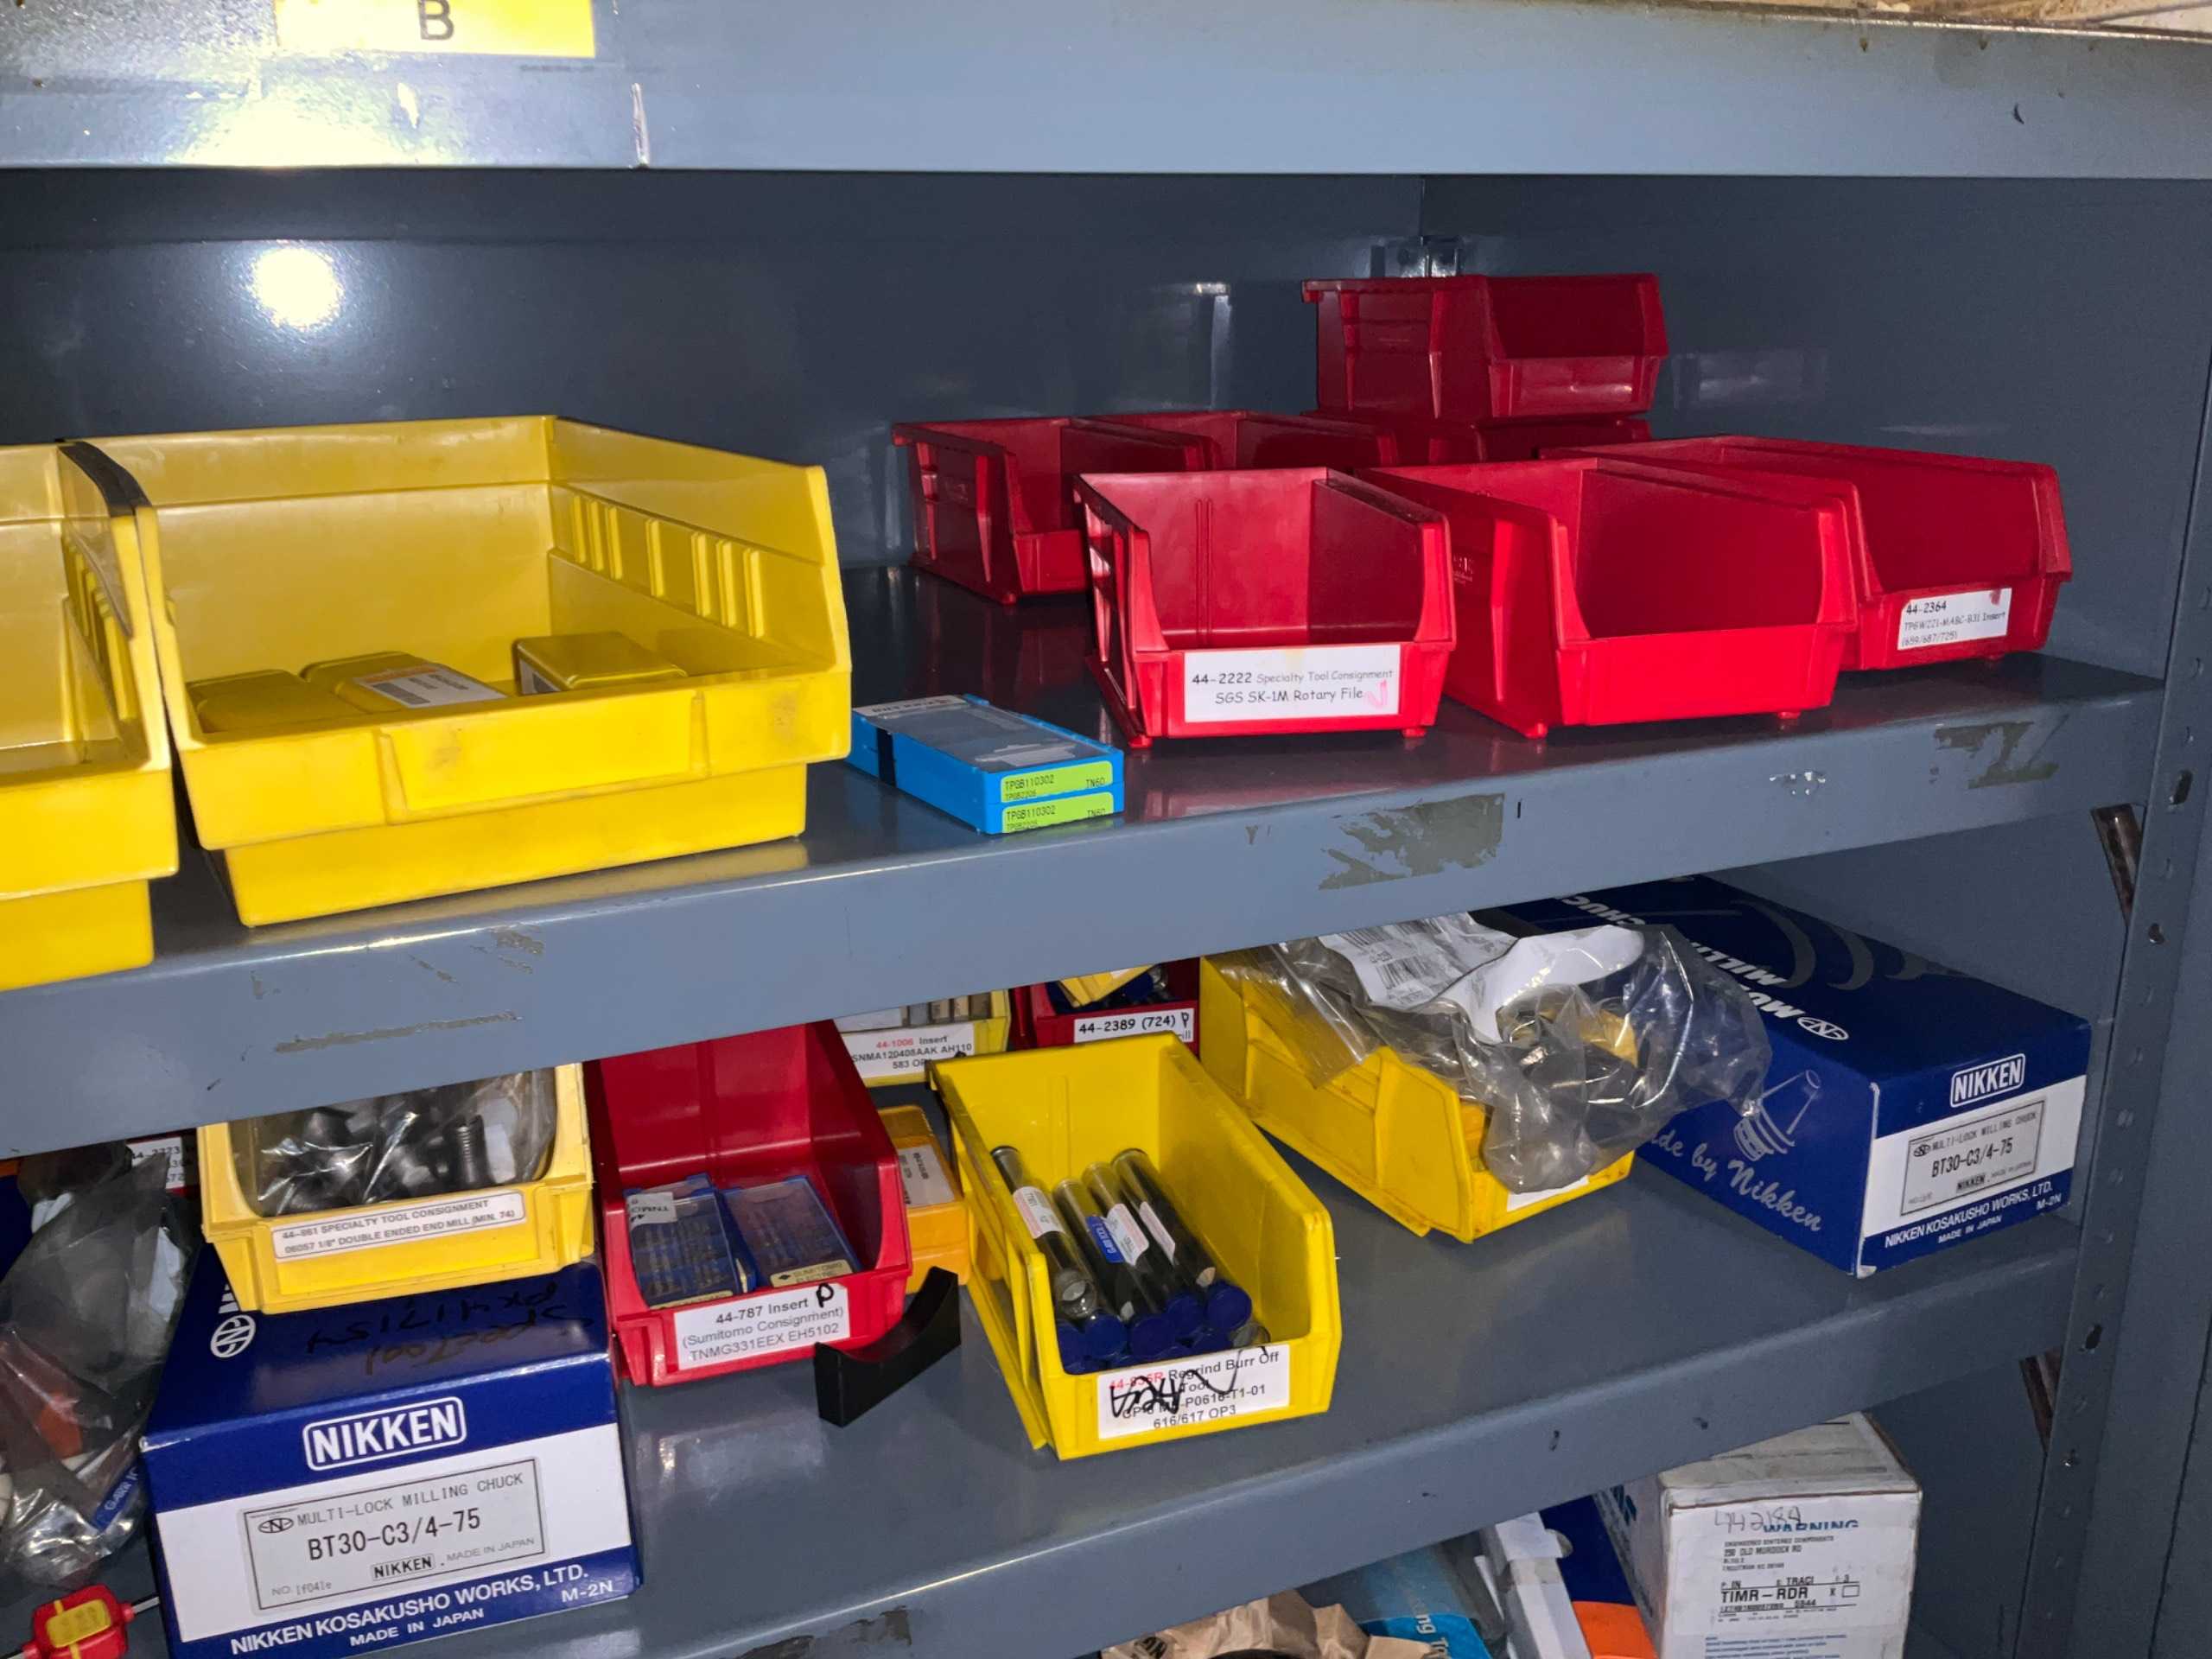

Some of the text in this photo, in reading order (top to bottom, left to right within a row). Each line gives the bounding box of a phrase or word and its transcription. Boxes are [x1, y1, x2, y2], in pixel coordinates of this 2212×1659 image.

[418, 0, 455, 41] B
[1906, 601, 1947, 614] 44-2364
[1983, 612, 2005, 621] Insert
[1192, 669, 1393, 685] 44-2222 Specialty Tool Consignment
[1215, 687, 1363, 705] SGS SK-1M Rotary File
[1005, 774, 1054, 790] TPGB110302
[1007, 805, 1056, 821] TPGB110302
[1561, 895, 1646, 926] CHUC
[1079, 1014, 1176, 1034] 44-2389 (724)
[918, 1036, 948, 1045] Insert
[941, 1044, 972, 1053] AH110
[893, 1059, 909, 1070] 583
[1954, 1057, 2023, 1103] NIKKEN
[1932, 1129, 1978, 1151] MULTI-LOCK
[1981, 1119, 2012, 1135] MILLING
[1931, 1137, 2013, 1178] BT30-C3/4-75
[1651, 1129, 1821, 1231] de by Nikken
[1957, 1175, 1986, 1190] NIKKEN
[321, 1217, 378, 1234] SPECIALTY
[382, 1213, 410, 1224] TOOL
[411, 1200, 489, 1219] CONSIGNMENT
[1885, 1224, 1925, 1248] NIKKEN
[1926, 1202, 1990, 1235] KOSAKUSHO
[2032, 1180, 2053, 1198] LTD.
[338, 1231, 382, 1246] DOUBLE
[384, 1224, 421, 1237] ENDED
[423, 1221, 445, 1231] END
[446, 1217, 469, 1228] MILL
[1938, 1215, 2002, 1244] MADE IN JAPAN
[816, 1282, 835, 1308] P
[715, 1298, 809, 1324] 44-787 Insert
[683, 1306, 844, 1348] (Sumitomo Consignment)
[690, 1323, 839, 1362] TNMG331EEX EH5102
[1168, 1361, 1221, 1381] Regrind
[1226, 1357, 1255, 1371] Burr
[1259, 1351, 1280, 1364] Off
[1154, 1405, 1236, 1429] 616/617 OP3
[310, 1405, 459, 1465] NIKKEN
[297, 1497, 394, 1527] MULTI-LOCK
[403, 1484, 468, 1507] MILLING
[477, 1472, 524, 1493] CHUCK
[308, 1507, 480, 1560] BT30-C3/4-75
[373, 1537, 535, 1580] NIKKEN MADE IN JAPAN
[561, 1580, 613, 1604] M-2N
[1721, 1589, 1759, 1604] TIMR
[1776, 1586, 1808, 1600] RDR
[231, 1563, 588, 1656] NIKKEN KOSAKUSHO WORKS, LTD.
[349, 1607, 485, 1648] MADE IN JAPAN
